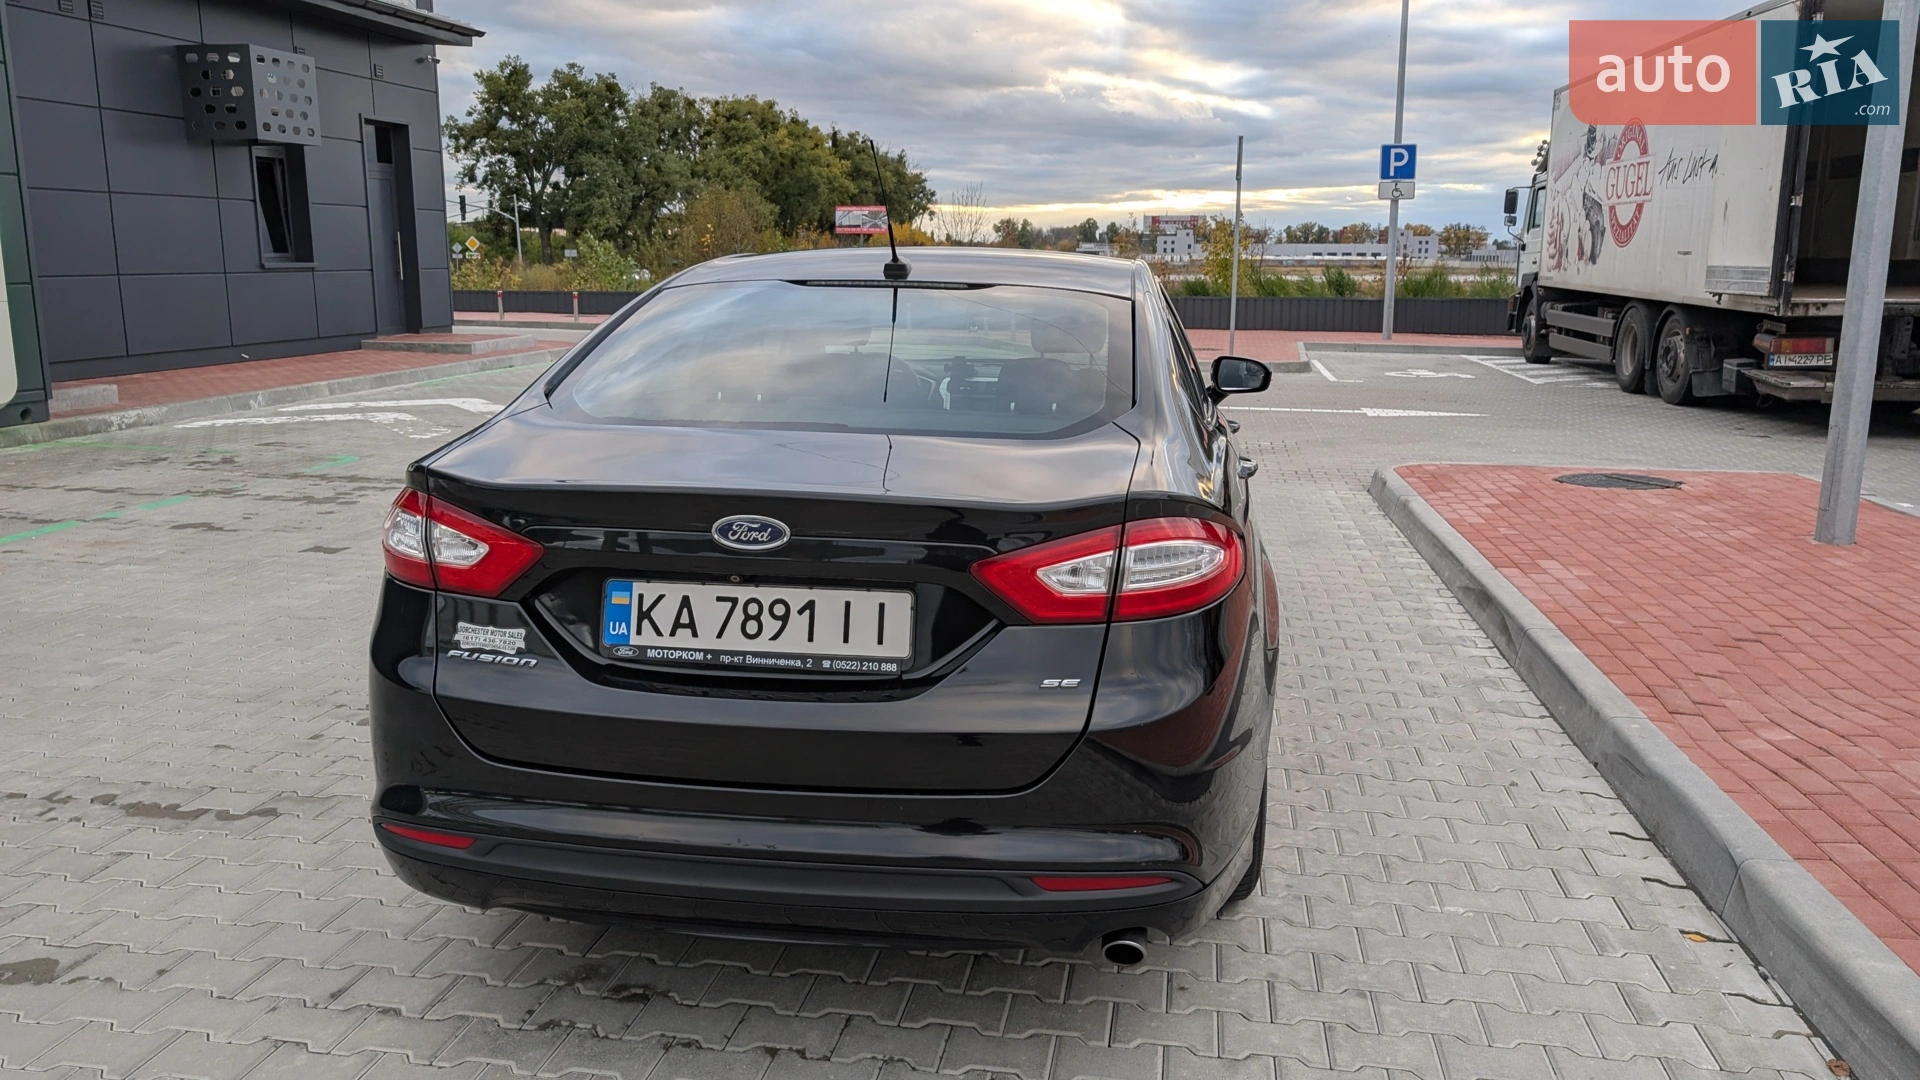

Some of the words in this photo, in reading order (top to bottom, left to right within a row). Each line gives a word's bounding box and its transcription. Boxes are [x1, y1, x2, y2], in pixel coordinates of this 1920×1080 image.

[1390, 148, 1409, 177] P
[1605, 160, 1653, 201] GUGEL
[1789, 355, 1815, 365] 4227
[728, 521, 772, 541] Ford
[636, 593, 699, 638] KA
[715, 595, 816, 643] 7891
[843, 600, 886, 646] II
[460, 626, 490, 636] DORCHESTER
[490, 629, 507, 638] MOTOR
[507, 631, 523, 640] SALES
[609, 621, 628, 635] UA
[482, 638, 517, 646] 436-7820
[446, 650, 538, 667] FUSION
[617, 647, 635, 656] Ford
[646, 648, 704, 661] МОТОРКОМ
[719, 654, 744, 665] пр-кт
[745, 655, 804, 668] Винниченка,
[806, 659, 813, 668] 2
[832, 660, 861, 671] (0522)
[862, 661, 879, 671] 210
[880, 662, 898, 672] 888
[1040, 679, 1081, 688] SE
